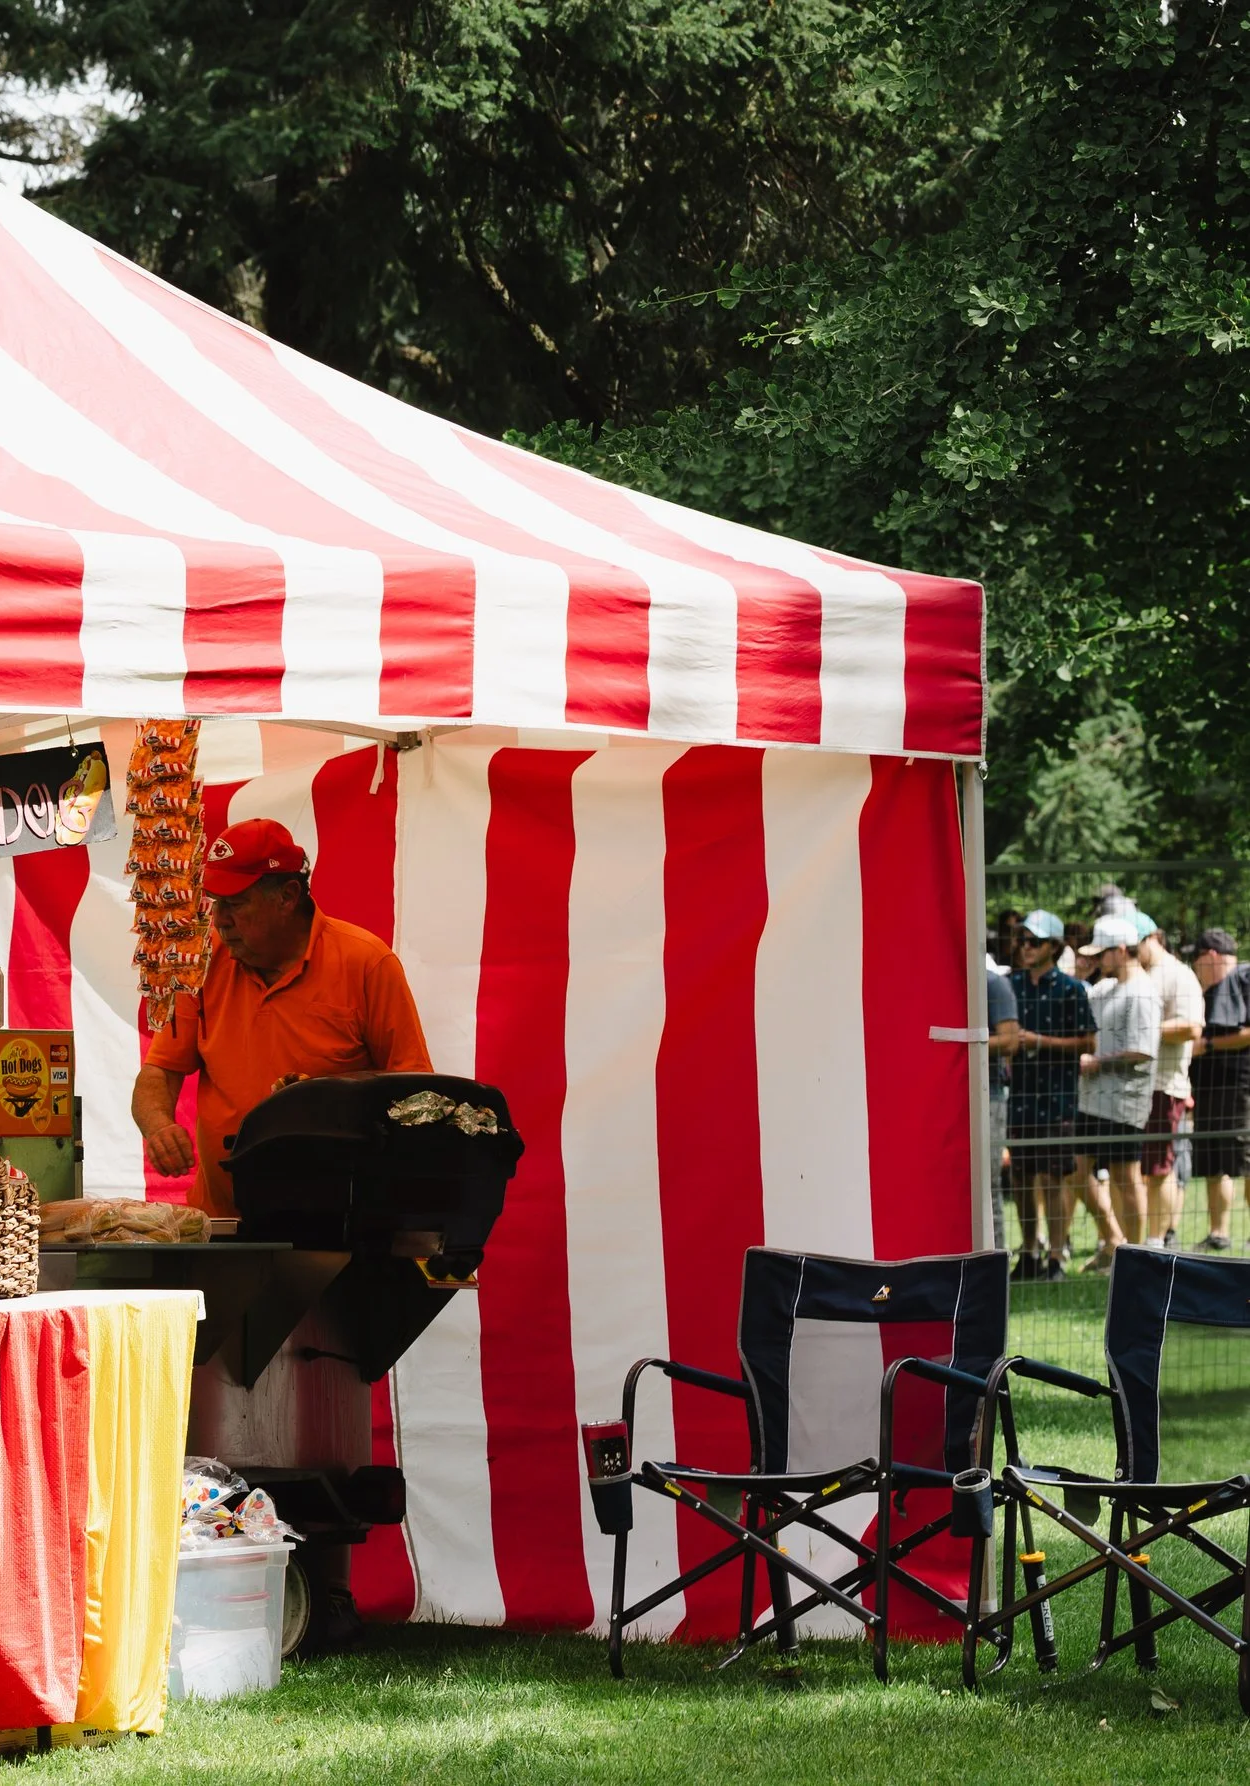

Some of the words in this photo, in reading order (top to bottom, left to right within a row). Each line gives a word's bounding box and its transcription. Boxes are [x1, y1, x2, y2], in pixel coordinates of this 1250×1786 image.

[1, 1059, 17, 1075] Hot
[20, 1057, 42, 1074] Dogs
[52, 1071, 68, 1080] VISA
